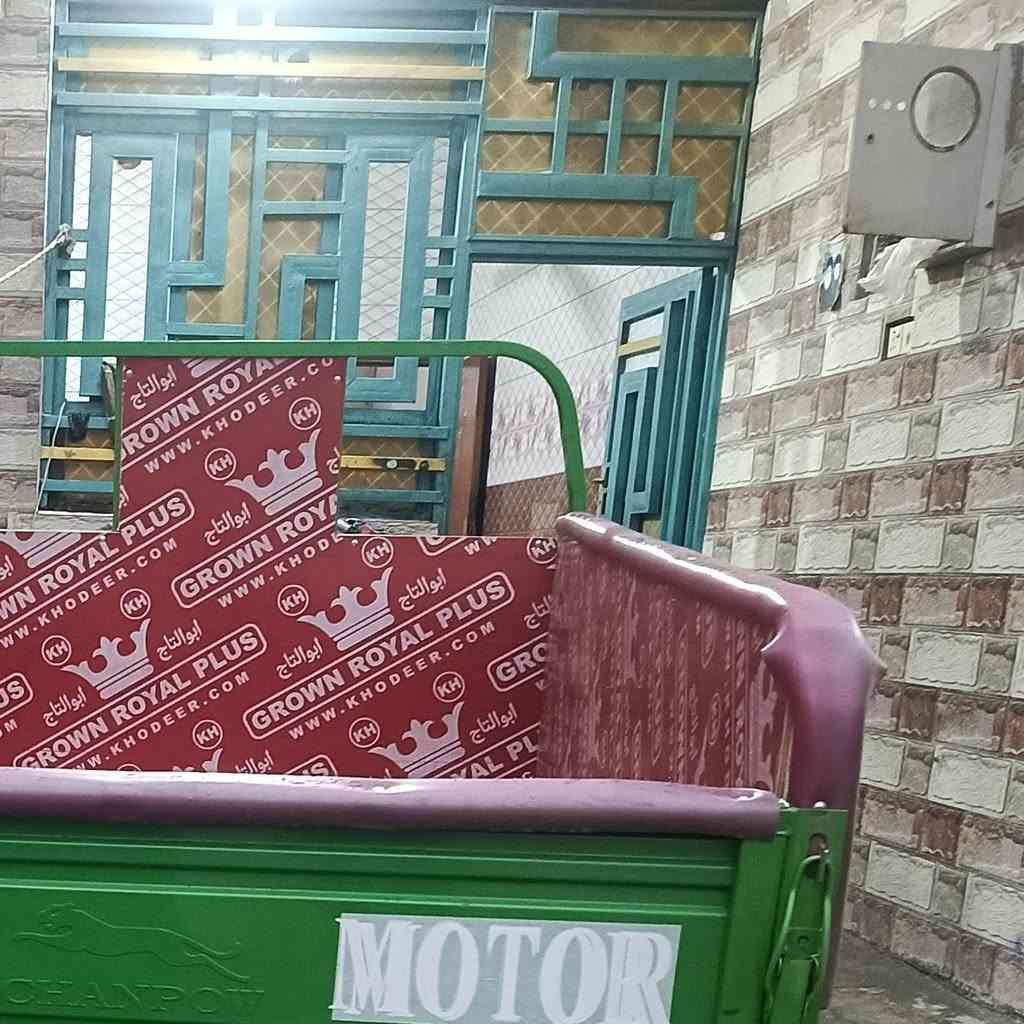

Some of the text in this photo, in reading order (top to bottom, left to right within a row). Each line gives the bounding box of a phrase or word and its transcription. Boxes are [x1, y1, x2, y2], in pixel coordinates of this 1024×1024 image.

[144, 358, 334, 474] WWW.KHODEER.CO
[292, 403, 318, 425] KH
[121, 397, 201, 460] ROWN
[208, 454, 234, 475] KH
[38, 538, 120, 595] ROYAL
[121, 497, 187, 546] PLUS
[179, 494, 337, 598] GROWN ROY
[365, 541, 391, 563] KH
[123, 595, 148, 615] KH
[280, 591, 306, 612] KH
[45, 641, 69, 662] KH
[251, 580, 506, 731] GROWN ROYAL PLUS
[495, 642, 549, 684] GRO
[288, 621, 496, 741] WWW.KHODEER.COM
[436, 677, 462, 698] KH
[22, 718, 108, 768] GROWN
[110, 674, 191, 725] ROYAL
[192, 631, 259, 678] PLUS
[74, 671, 250, 771] W.KHODEER.COM
[352, 723, 377, 744] KH
[196, 725, 220, 746] KH
[506, 735, 540, 763] PL
